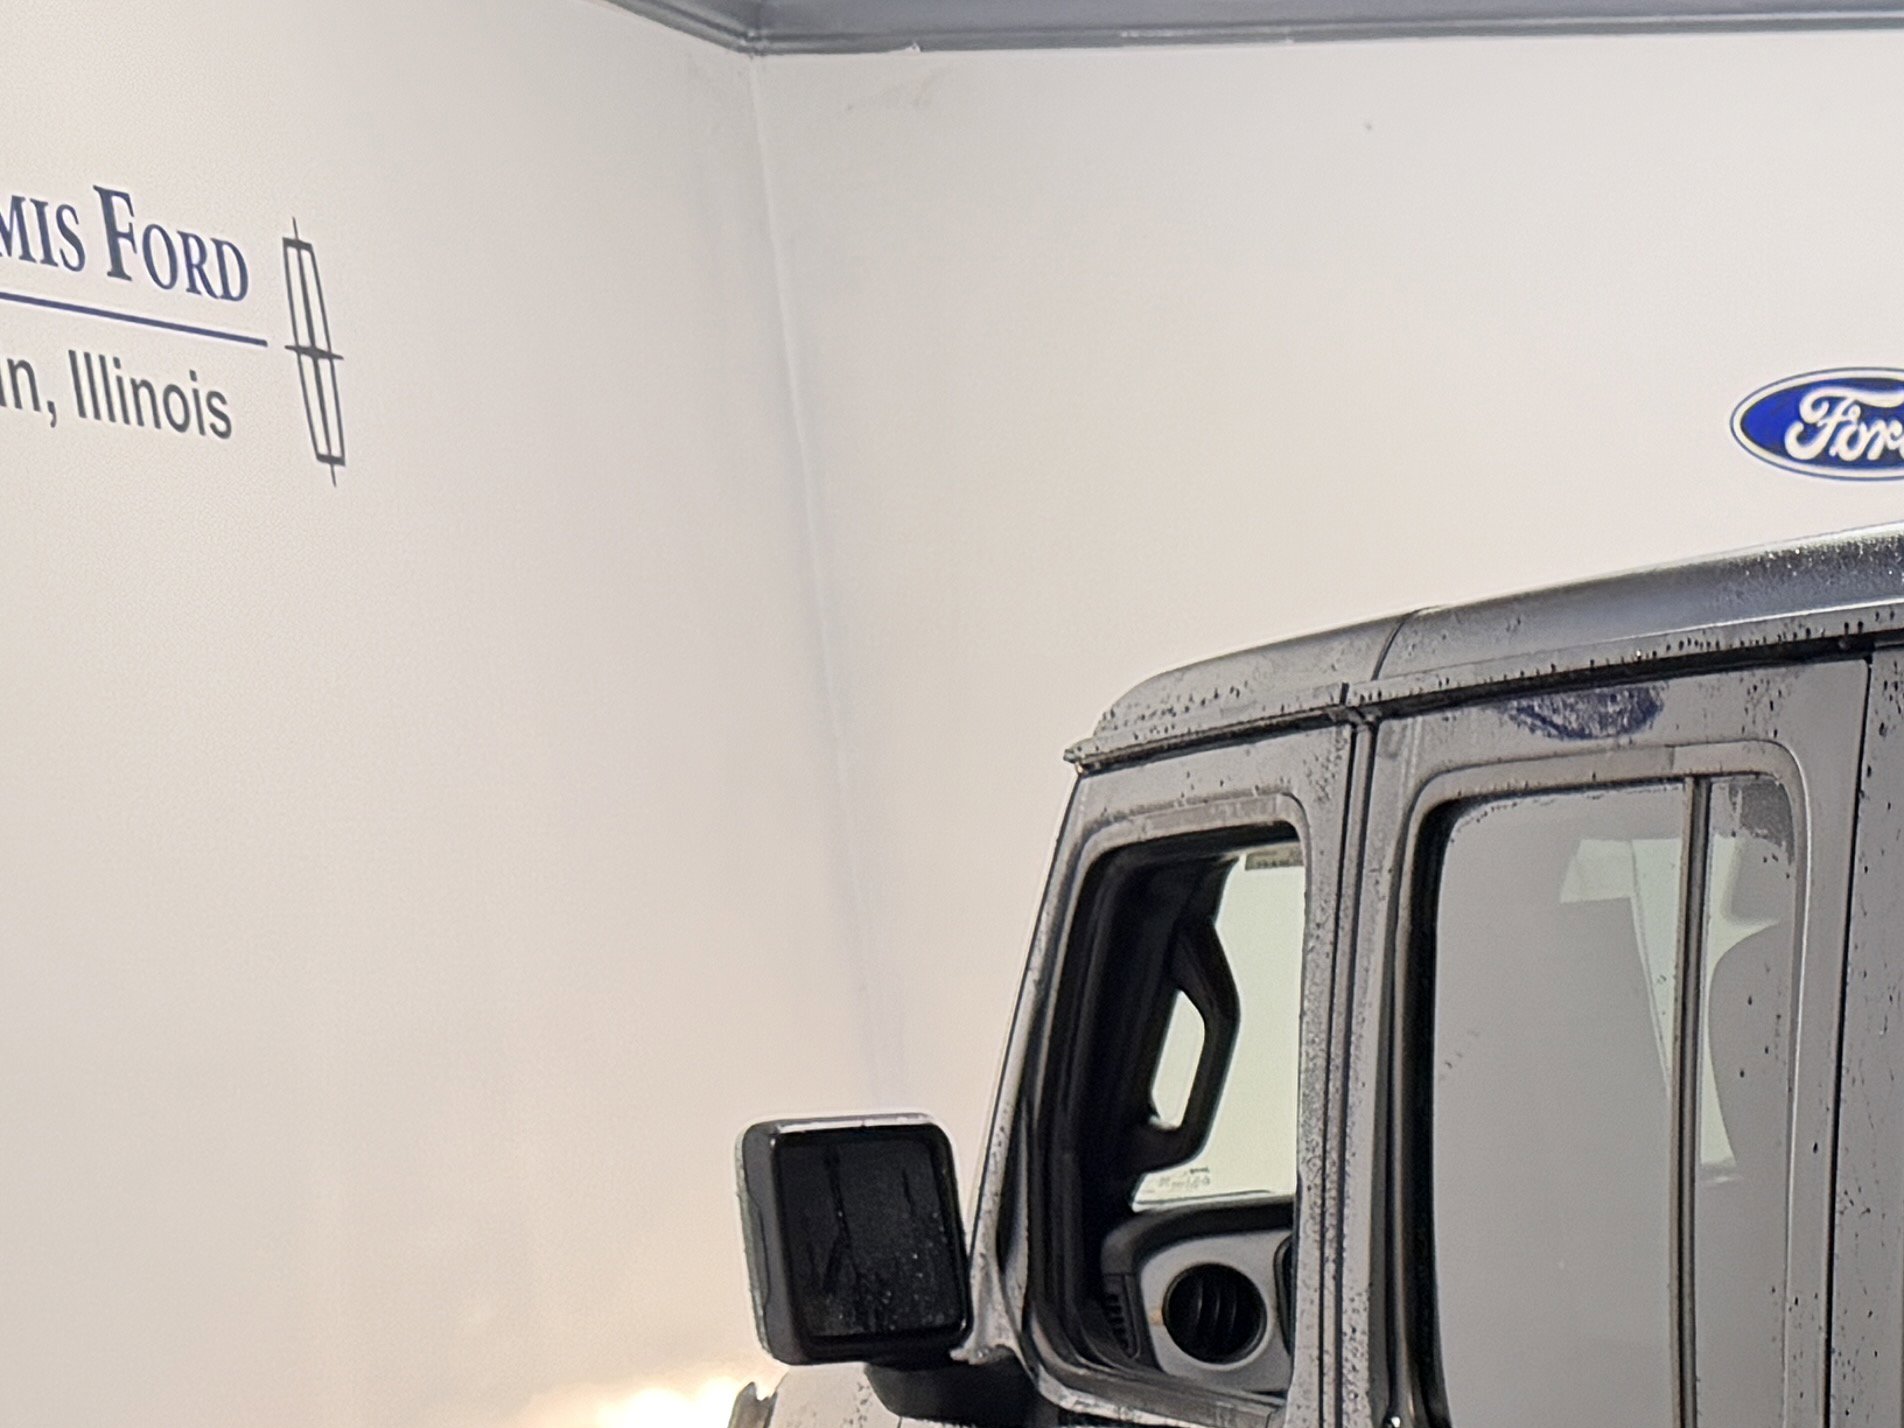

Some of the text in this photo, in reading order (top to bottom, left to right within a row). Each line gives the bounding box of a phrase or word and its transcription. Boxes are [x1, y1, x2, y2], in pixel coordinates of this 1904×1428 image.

[0, 185, 249, 302] MIS FORD
[68, 350, 232, 440] Illinois
